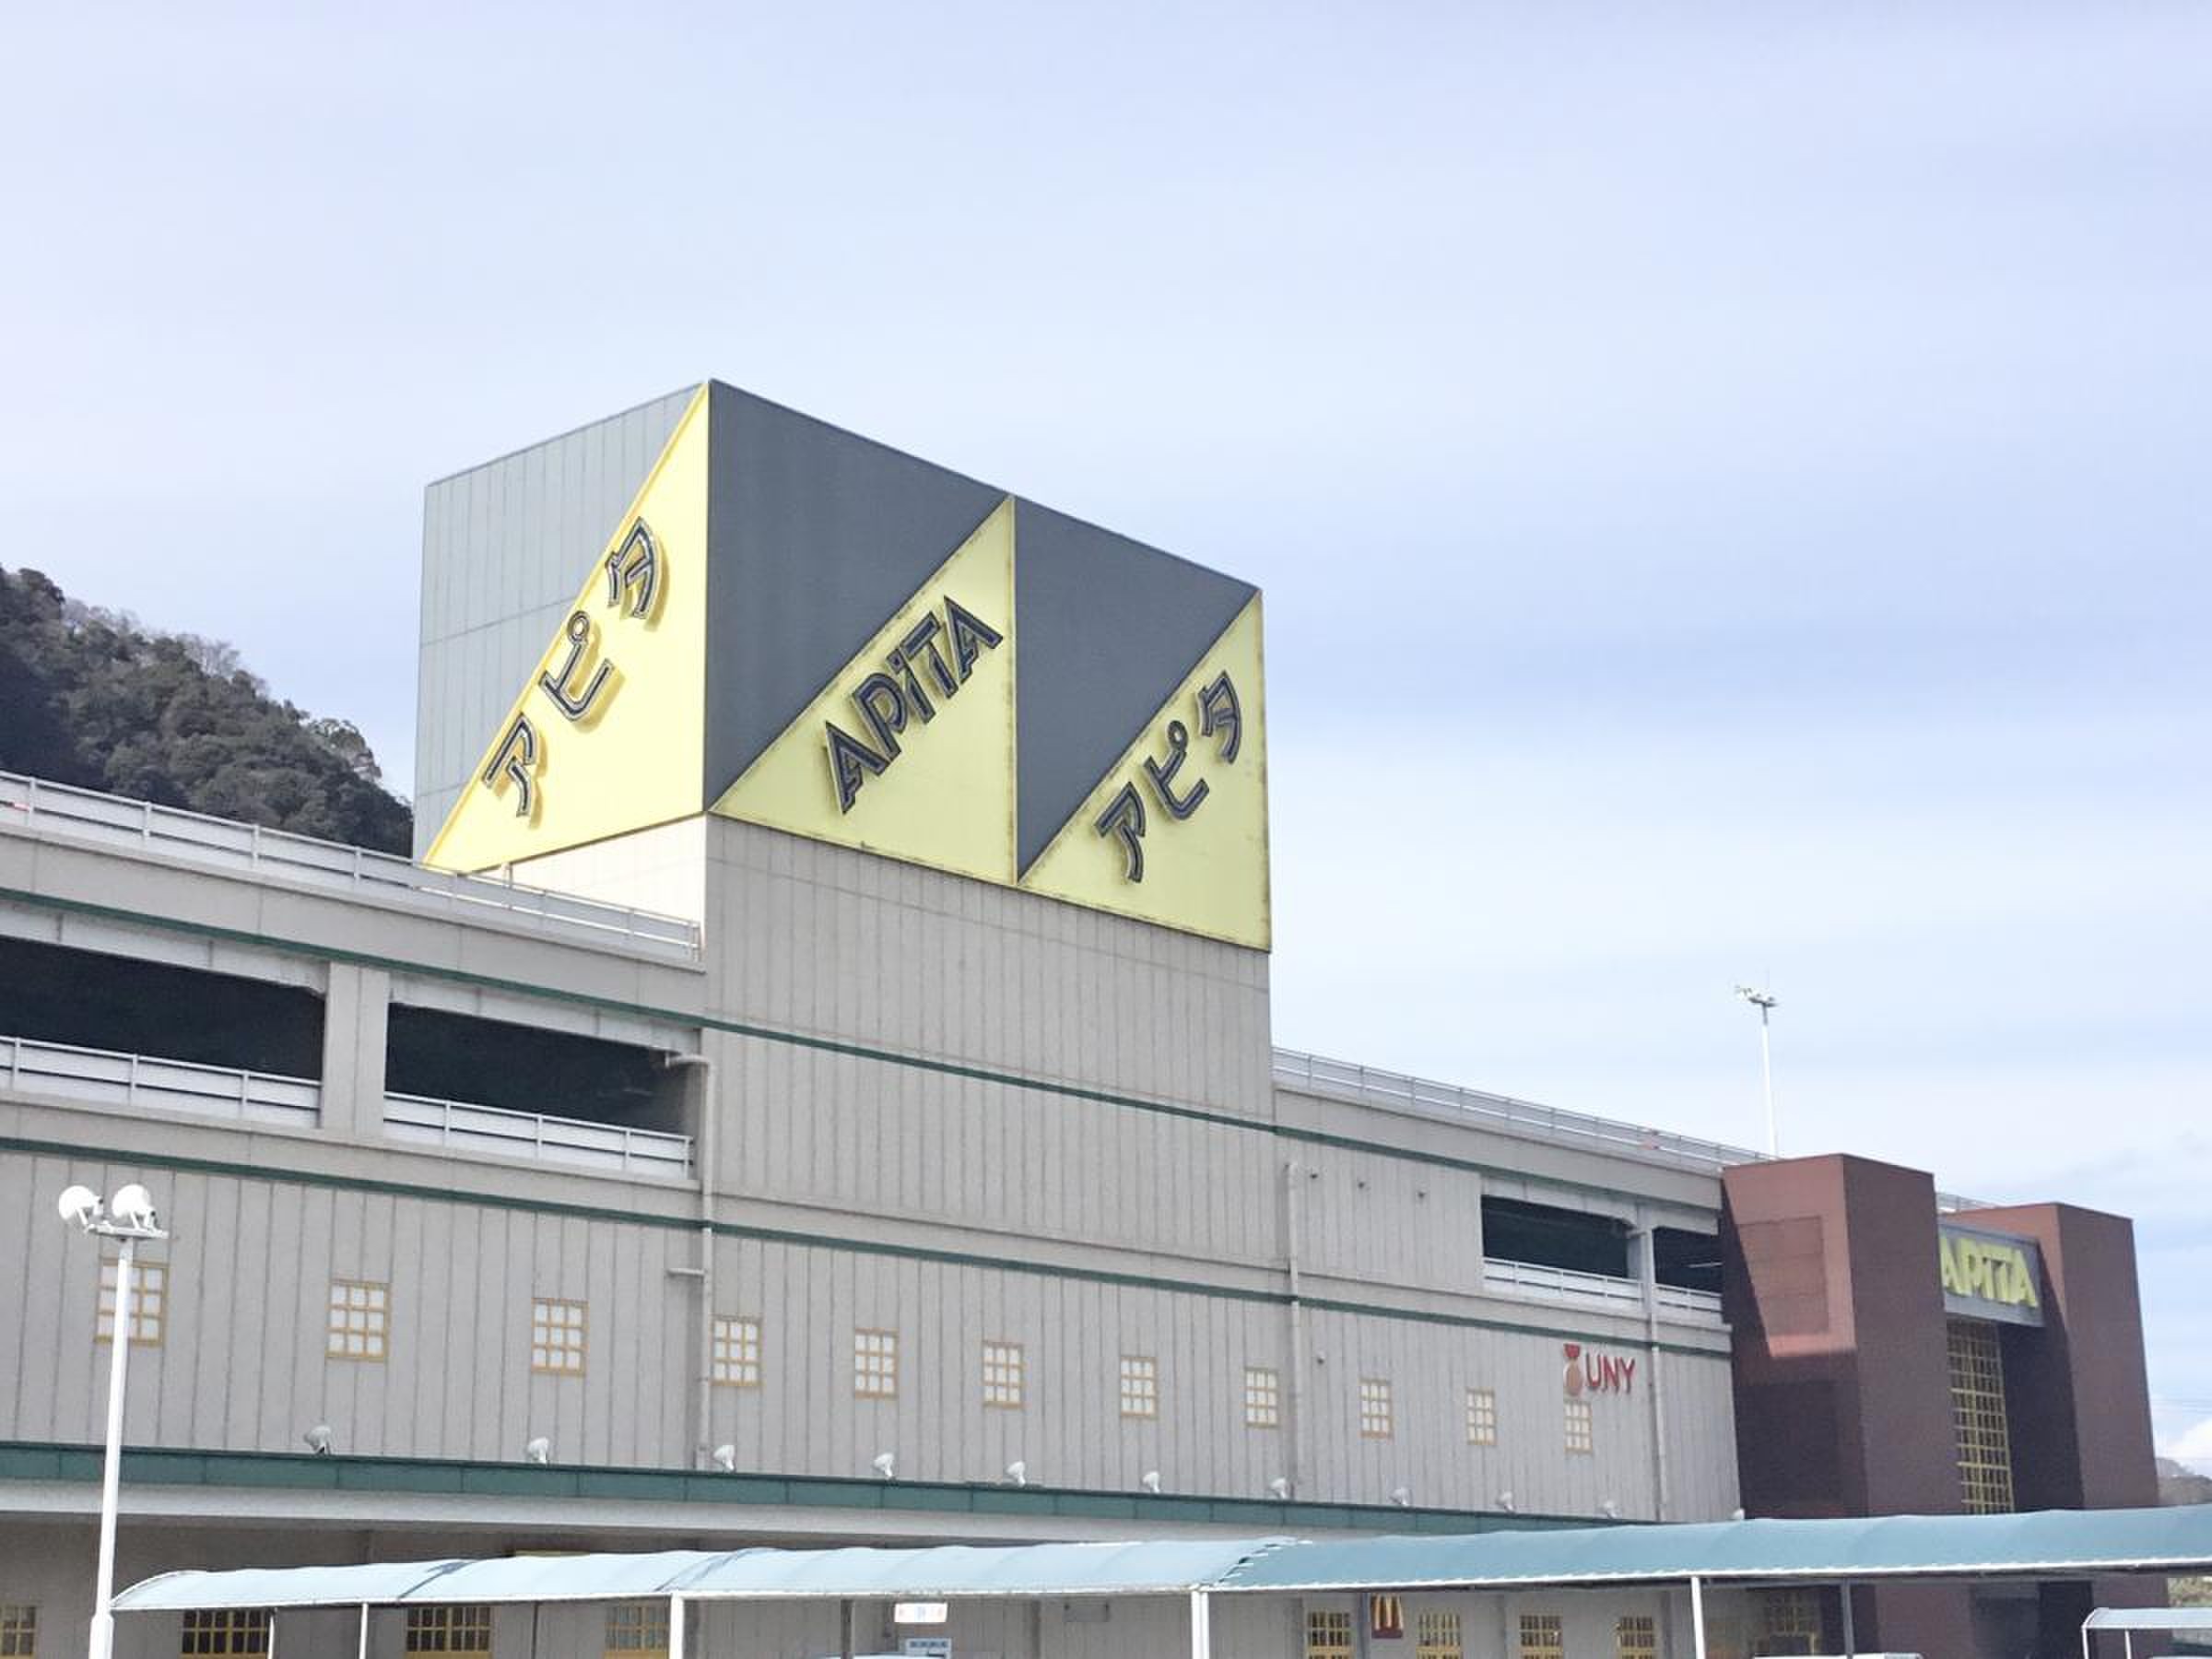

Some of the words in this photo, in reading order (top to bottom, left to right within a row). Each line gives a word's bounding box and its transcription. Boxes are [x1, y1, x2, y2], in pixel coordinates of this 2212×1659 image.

[481, 515, 662, 817] アピタ
[1094, 670, 1241, 883] アピタ
[1585, 1352, 1635, 1394] UNY
